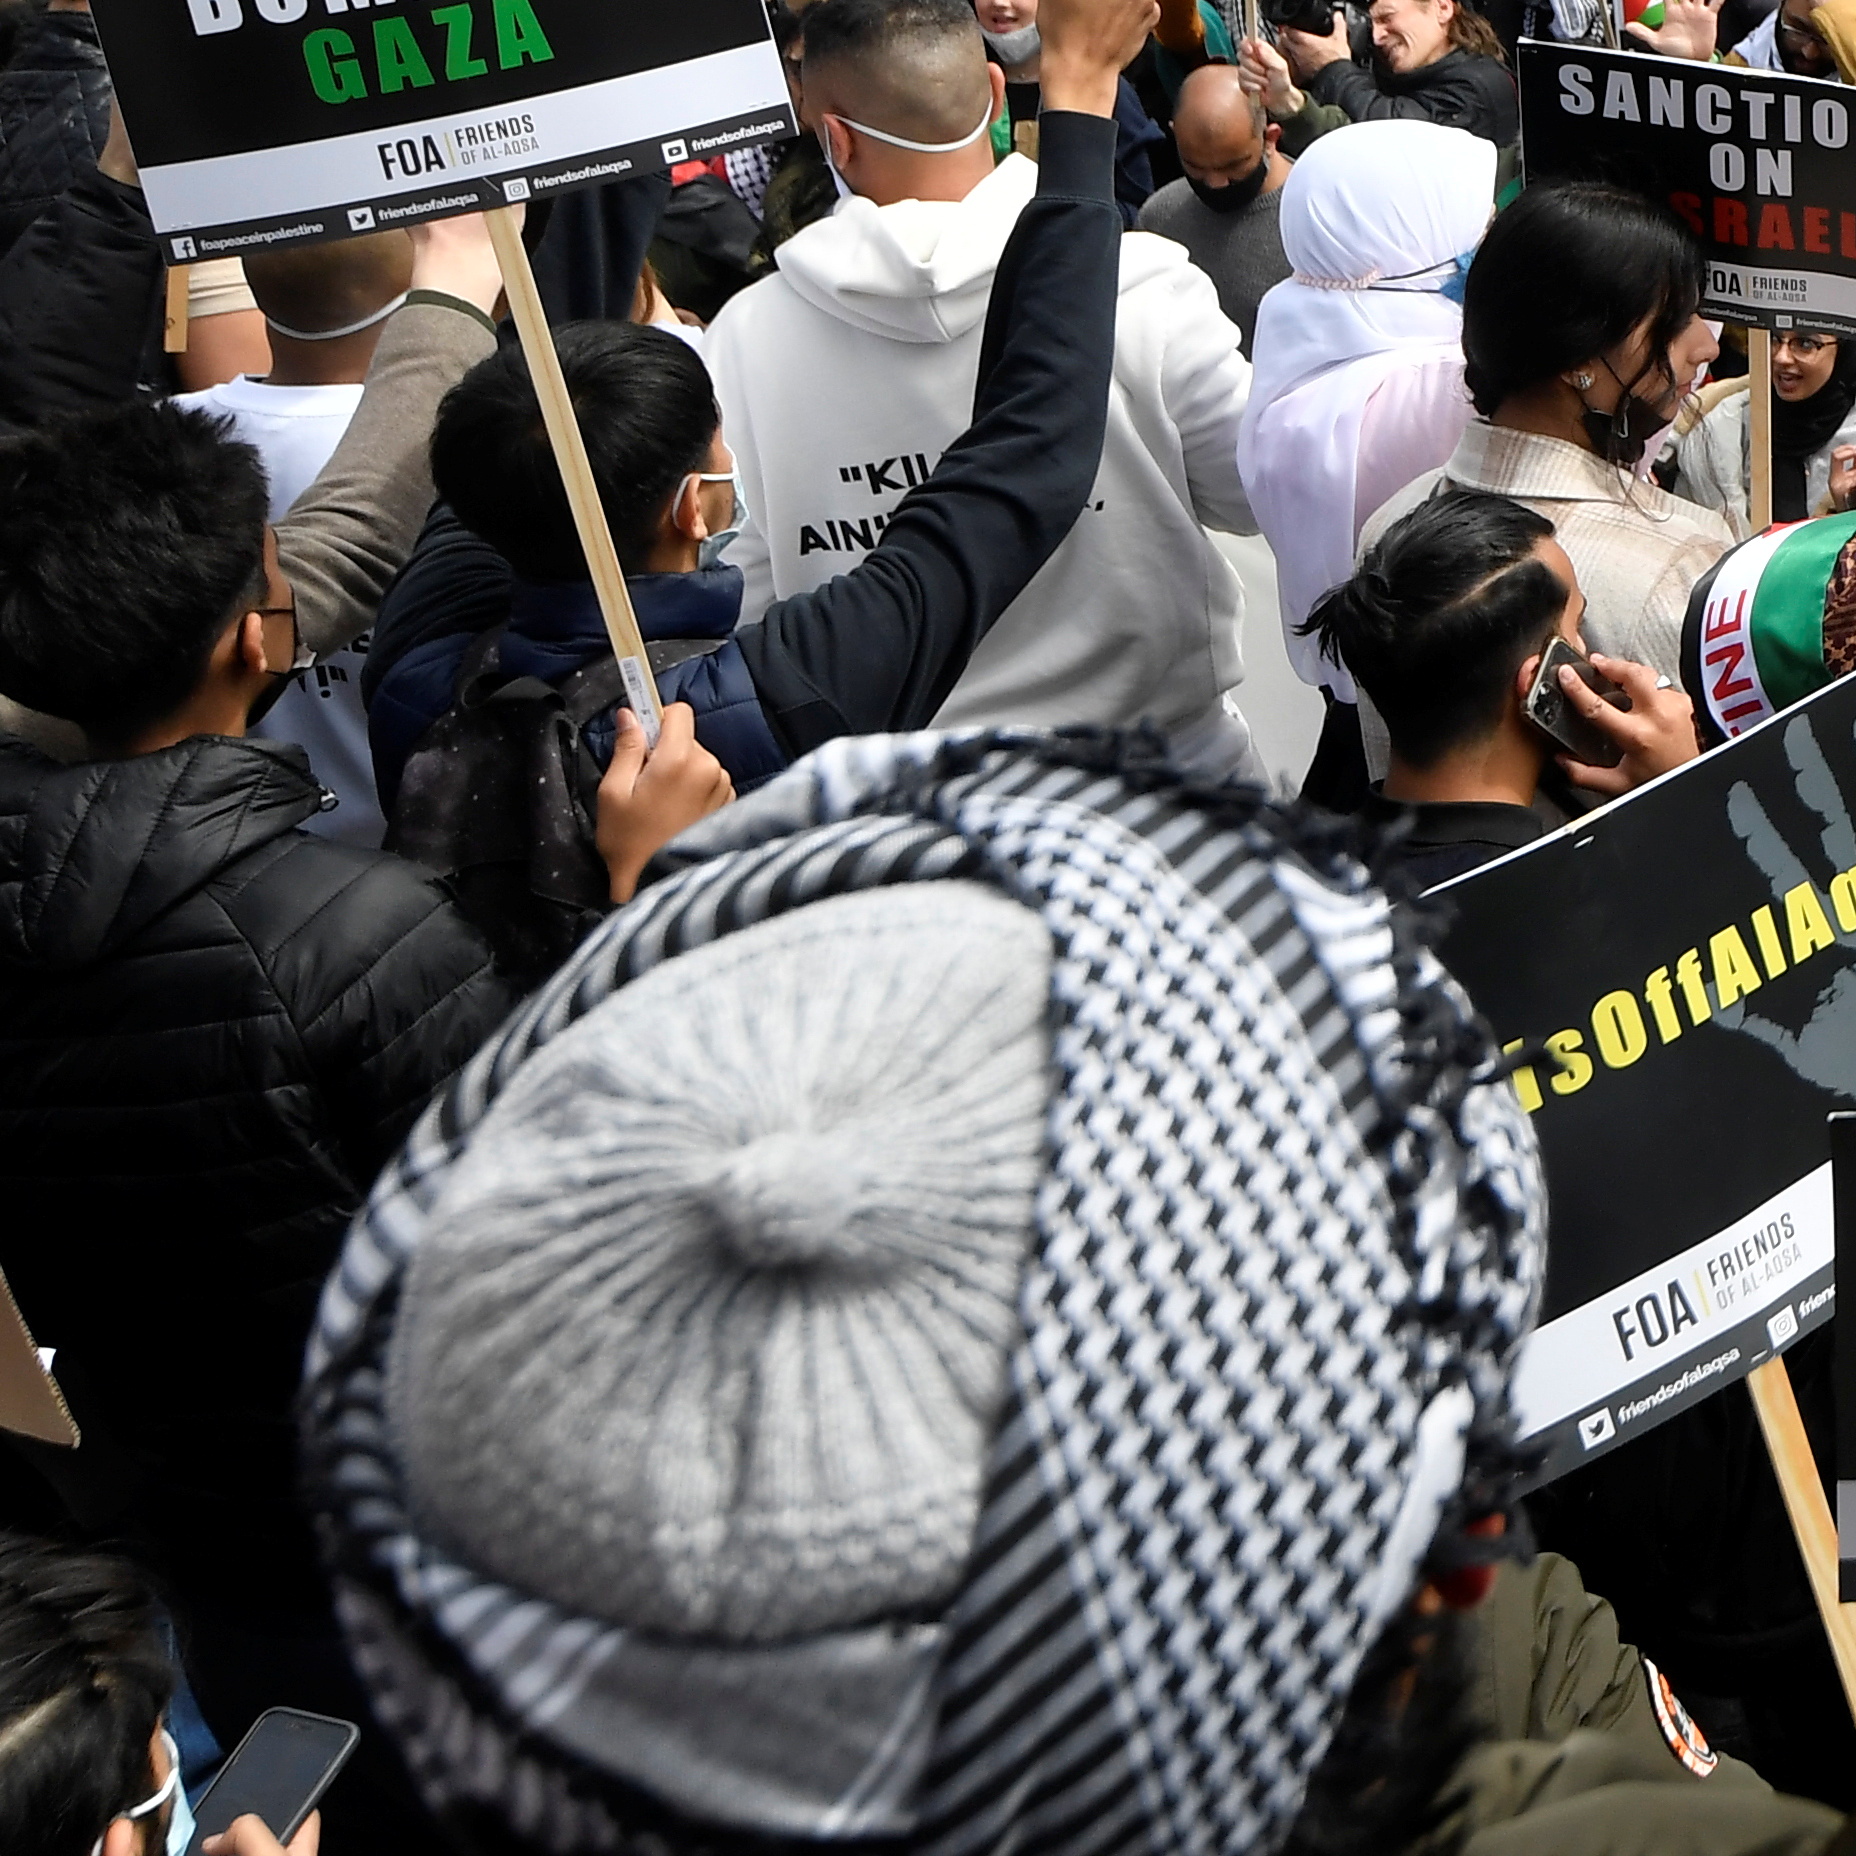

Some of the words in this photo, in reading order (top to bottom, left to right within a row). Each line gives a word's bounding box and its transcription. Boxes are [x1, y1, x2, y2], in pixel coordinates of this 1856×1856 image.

[455, 114, 535, 149] FRIENDS
[691, 120, 785, 152] friendsofalaqsa
[378, 139, 446, 180] FOA
[461, 147, 481, 164] OF
[484, 137, 540, 160] AL-AQSA
[534, 159, 632, 191] friendsofalaqsa
[1710, 143, 1793, 197] ON
[378, 192, 479, 223] friendsofalaqsa
[200, 221, 324, 253] foapeaceinpalestine
[1753, 276, 1808, 292] FRIENDS
[1706, 1212, 1797, 1288] FRIENDS
[1715, 1283, 1738, 1310] OF
[1740, 1242, 1804, 1301] AL-AQSA
[1612, 1279, 1699, 1362] FOA
[1617, 1345, 1740, 1424] friendsofalaqsa
